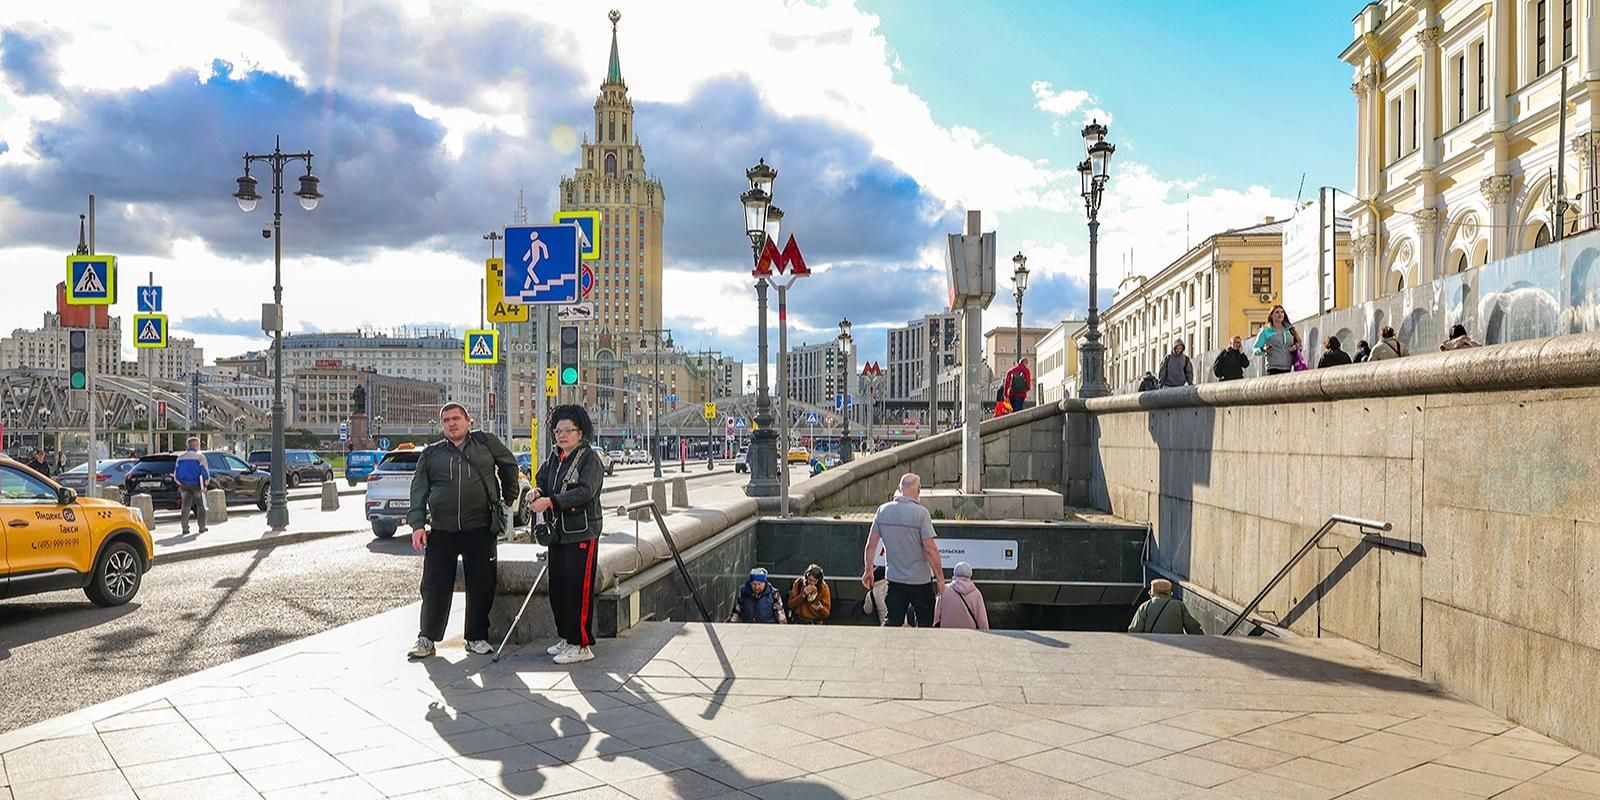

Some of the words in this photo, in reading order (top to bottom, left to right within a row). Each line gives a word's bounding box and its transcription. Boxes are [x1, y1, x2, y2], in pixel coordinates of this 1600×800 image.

[752, 234, 810, 277] М
[35, 511, 63, 521] Яндекс
[59, 525, 79, 534] Такси
